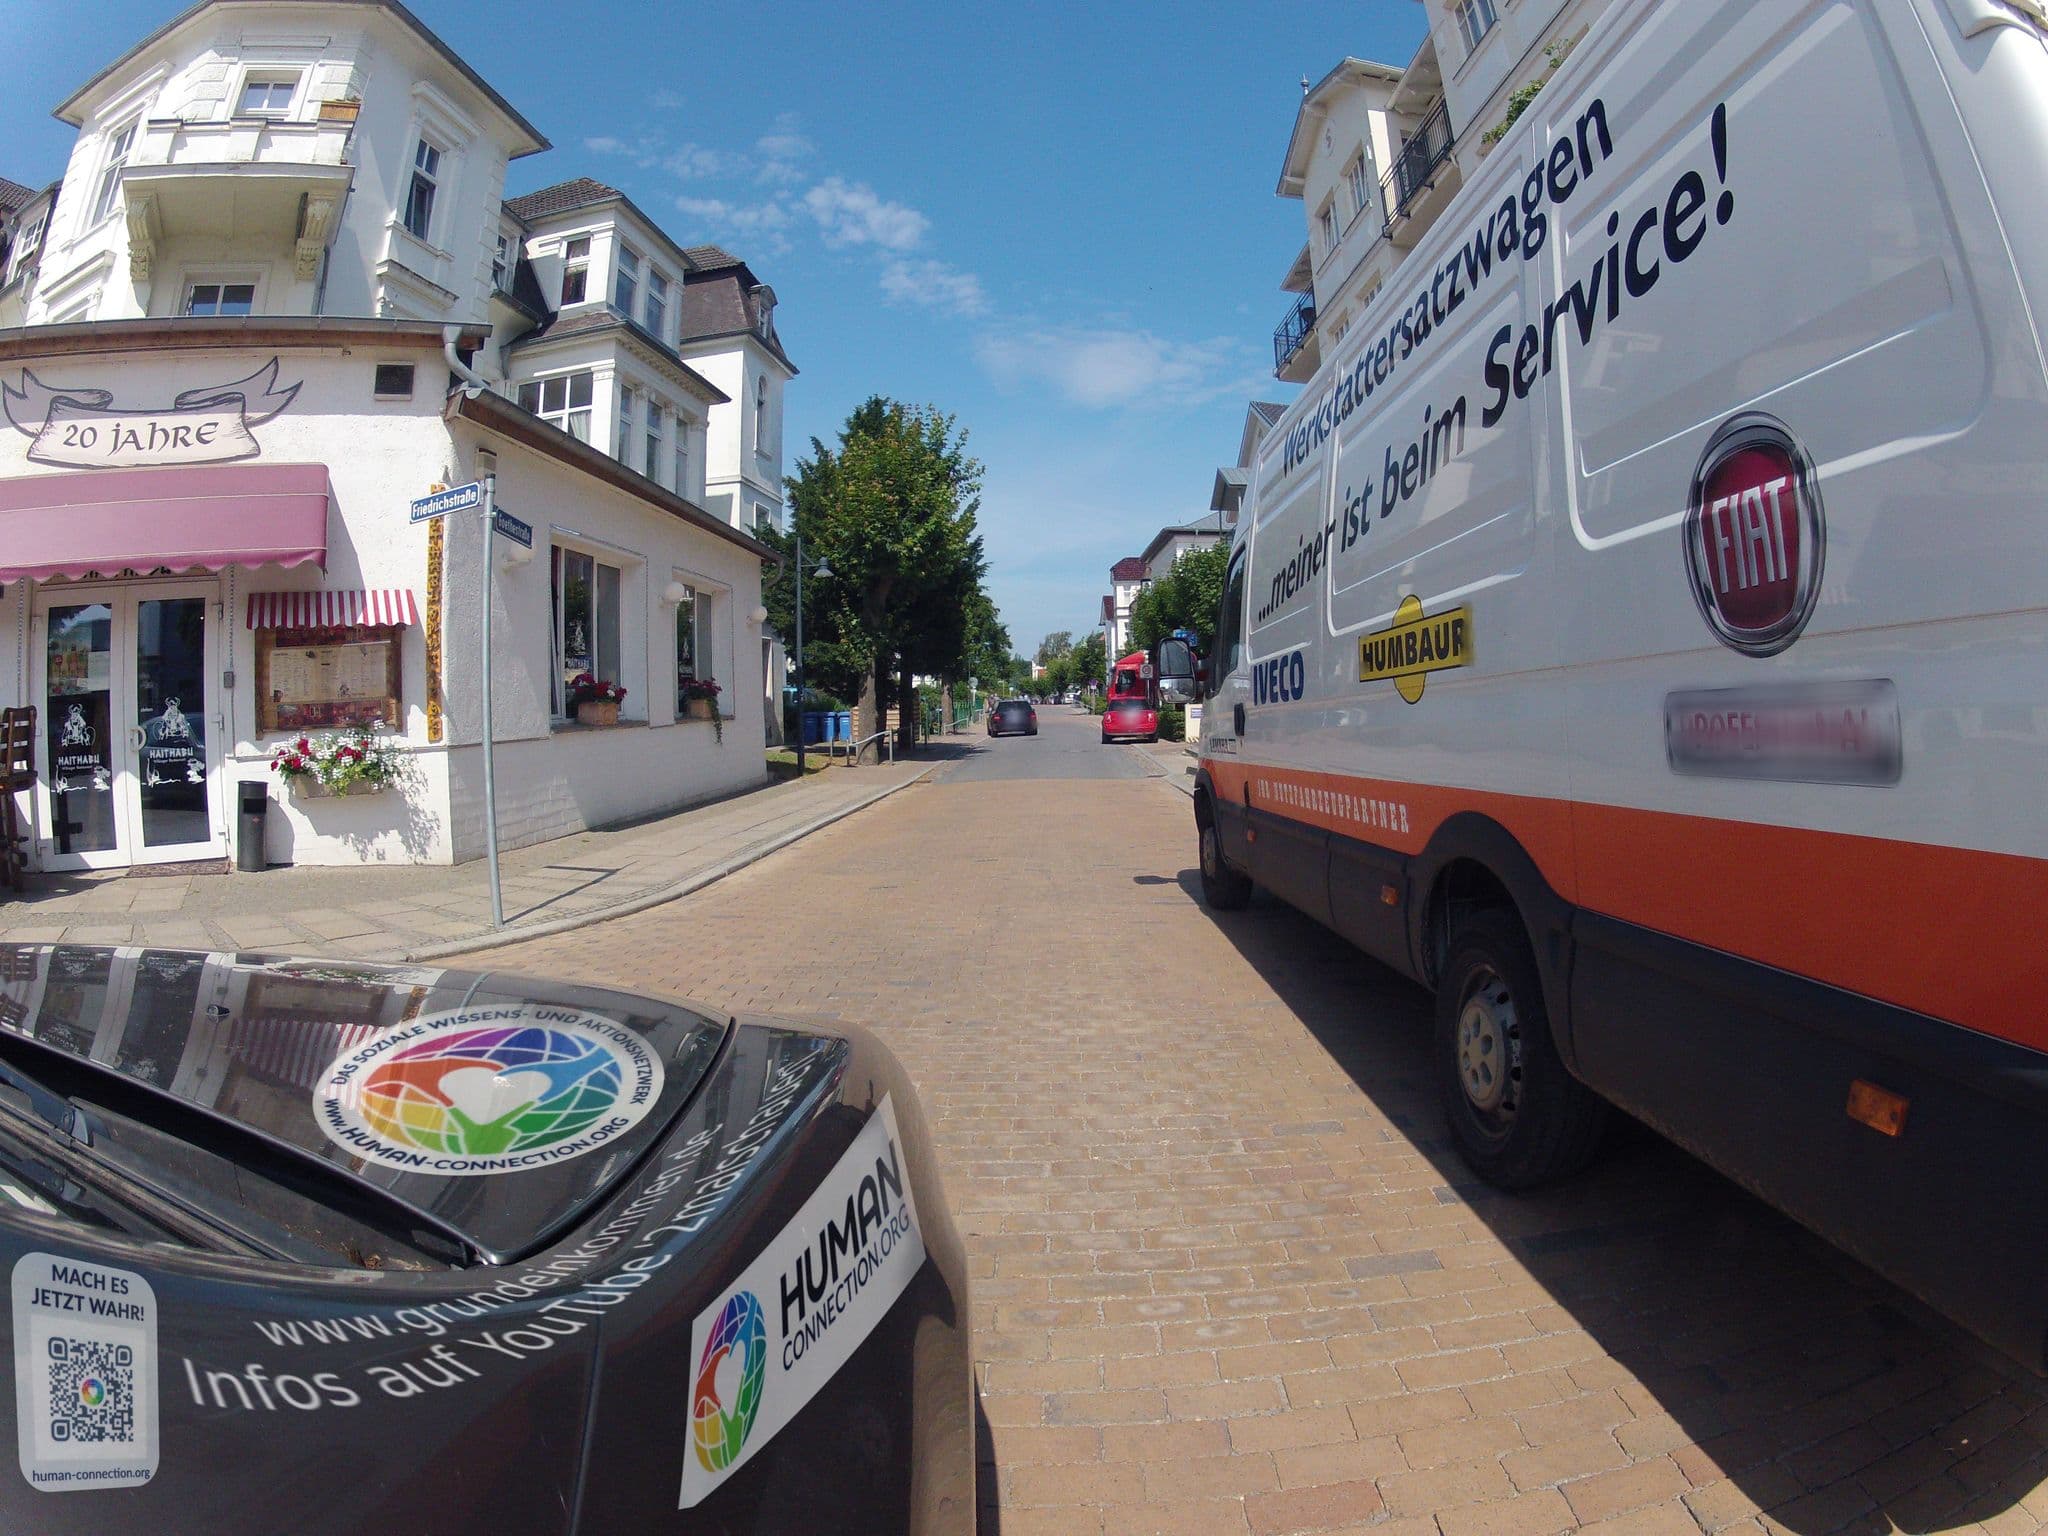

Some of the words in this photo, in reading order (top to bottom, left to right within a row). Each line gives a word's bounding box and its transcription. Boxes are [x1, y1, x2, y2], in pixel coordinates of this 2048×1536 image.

[1283, 98, 1614, 478] Werkstattersatzwagen
[1341, 473, 1373, 553] ist
[1380, 394, 1467, 519] beim
[1480, 102, 1735, 429] Service!
[62, 422, 98, 449] 20
[412, 489, 477, 519] Friedrichstraße
[1710, 476, 1788, 594] FIAT
[1253, 650, 1305, 706] IVECO
[332, 1065, 358, 1086] DAS
[355, 1026, 427, 1064] SOZIALE
[426, 1008, 530, 1030] WISSENS-
[535, 1008, 580, 1025] UND
[578, 1016, 654, 1107] AKTIONSNETZWERK
[52, 1263, 107, 1292] MACH
[110, 1276, 130, 1295] ES
[254, 1123, 724, 1347] www.grundeinkommen.de
[779, 1138, 906, 1340] HUMAN
[781, 1202, 911, 1372] CONNECTION.ORG
[32, 1287, 85, 1313] JETZT
[88, 1297, 146, 1322] WAHR!
[182, 1357, 362, 1412] Infos
[366, 1344, 483, 1398] auf
[457, 1250, 673, 1361] YouTube
[32, 1466, 152, 1483] human-connection.org
